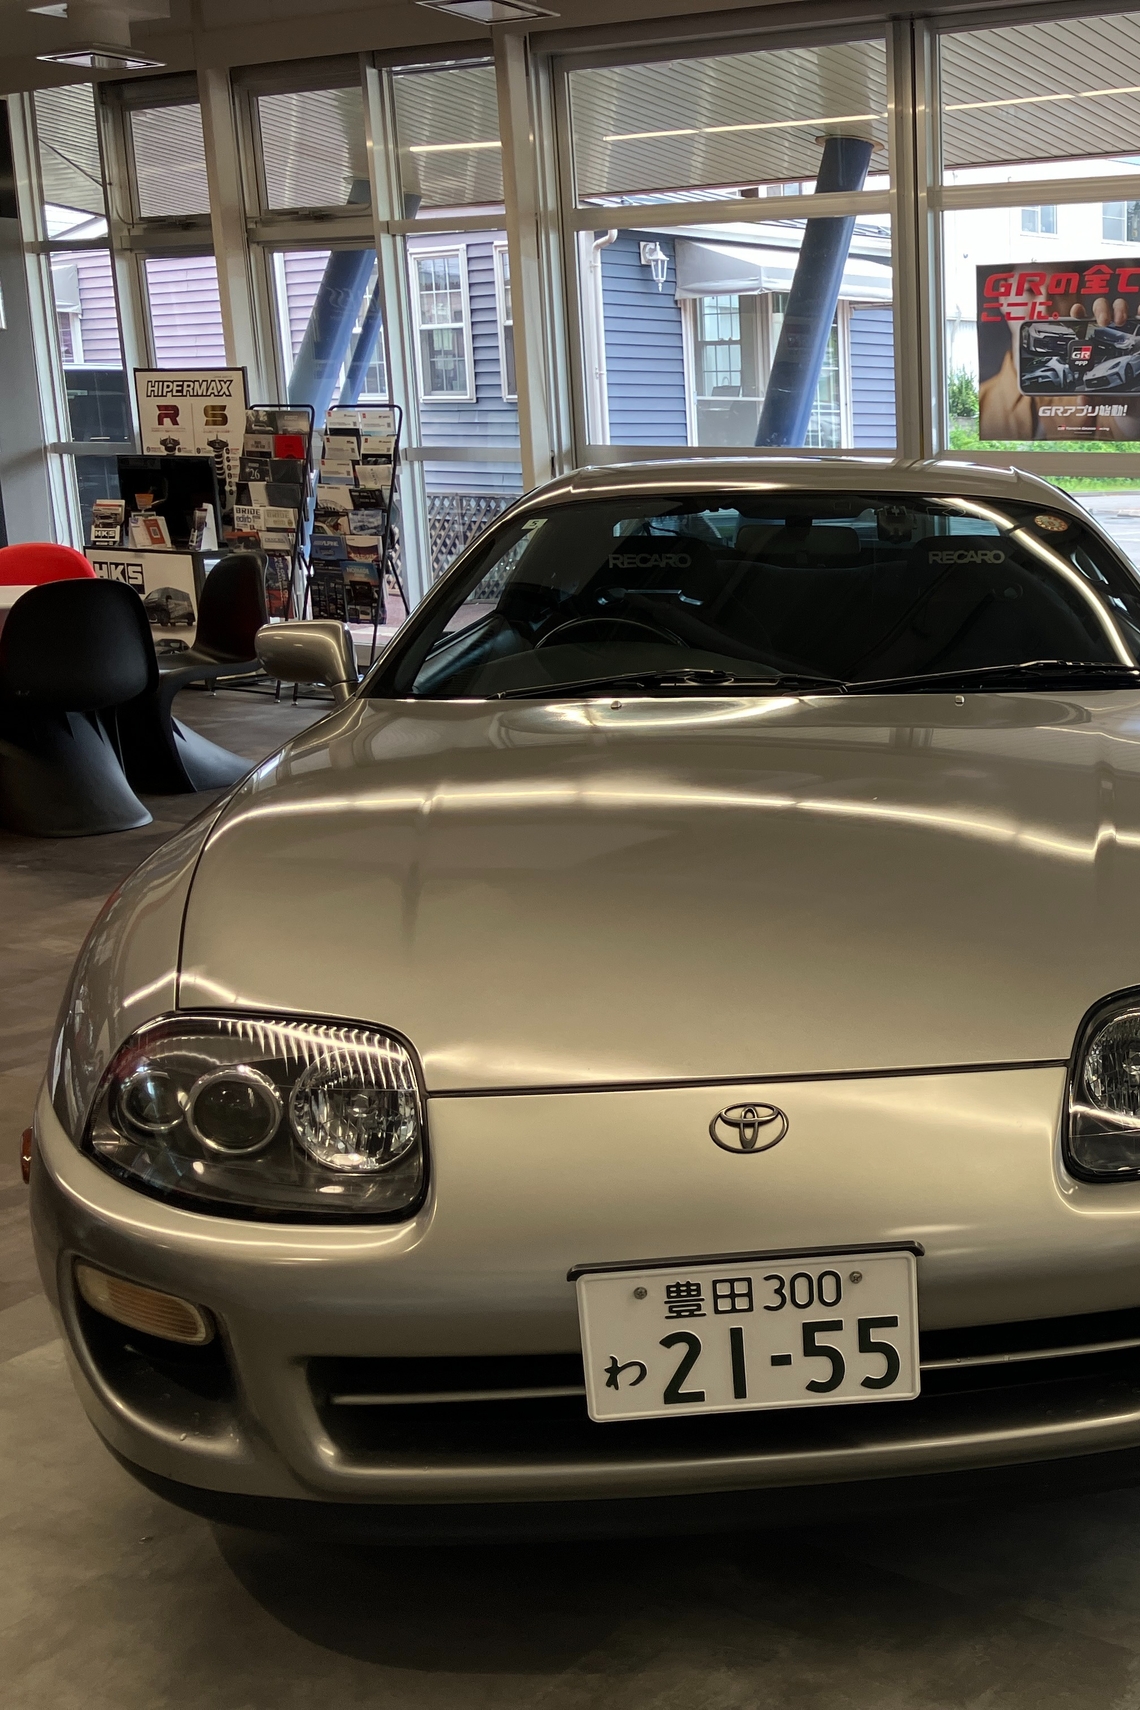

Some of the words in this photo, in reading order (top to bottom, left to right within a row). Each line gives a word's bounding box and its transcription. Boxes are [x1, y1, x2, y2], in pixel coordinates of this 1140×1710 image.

[980, 300, 1060, 322] ここに。
[146, 380, 233, 398] HIPERMAX
[156, 405, 180, 426] R
[204, 405, 228, 426] S
[250, 468, 260, 479] 26
[95, 530, 116, 538] HKS
[608, 554, 692, 568] RECARO
[928, 550, 1005, 564] RECARO
[93, 562, 144, 585] HKS
[663, 1276, 754, 1320] 豊田
[762, 1269, 843, 1312] 300
[603, 1354, 648, 1391] わ
[658, 1315, 902, 1405] 21-55
